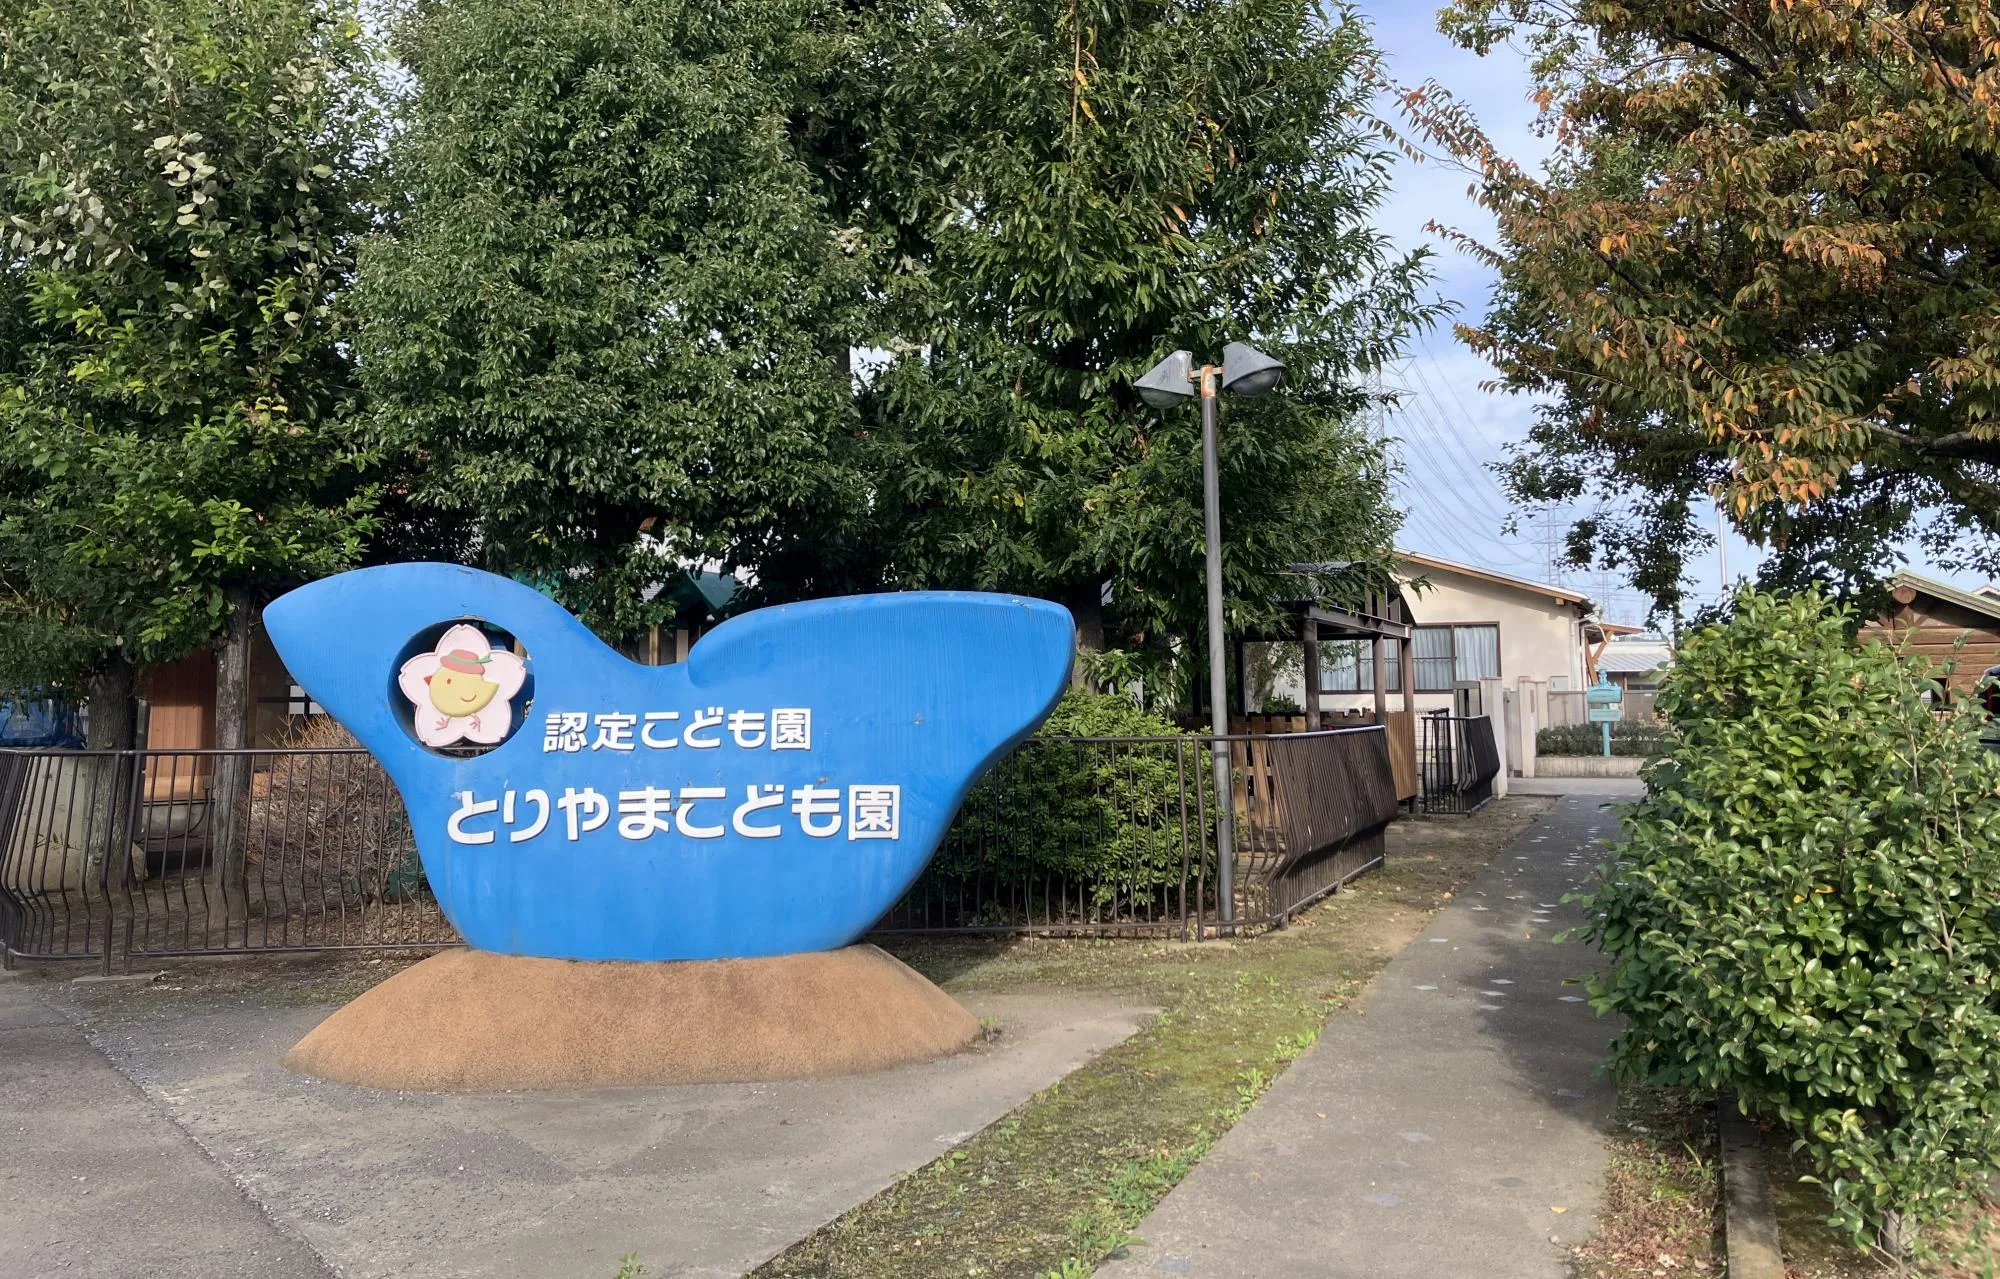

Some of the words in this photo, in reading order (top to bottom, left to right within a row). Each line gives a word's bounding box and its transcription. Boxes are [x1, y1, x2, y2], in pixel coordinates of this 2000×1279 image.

[543, 706, 812, 753] 認定こども園
[446, 784, 901, 845] とりやまこども園
